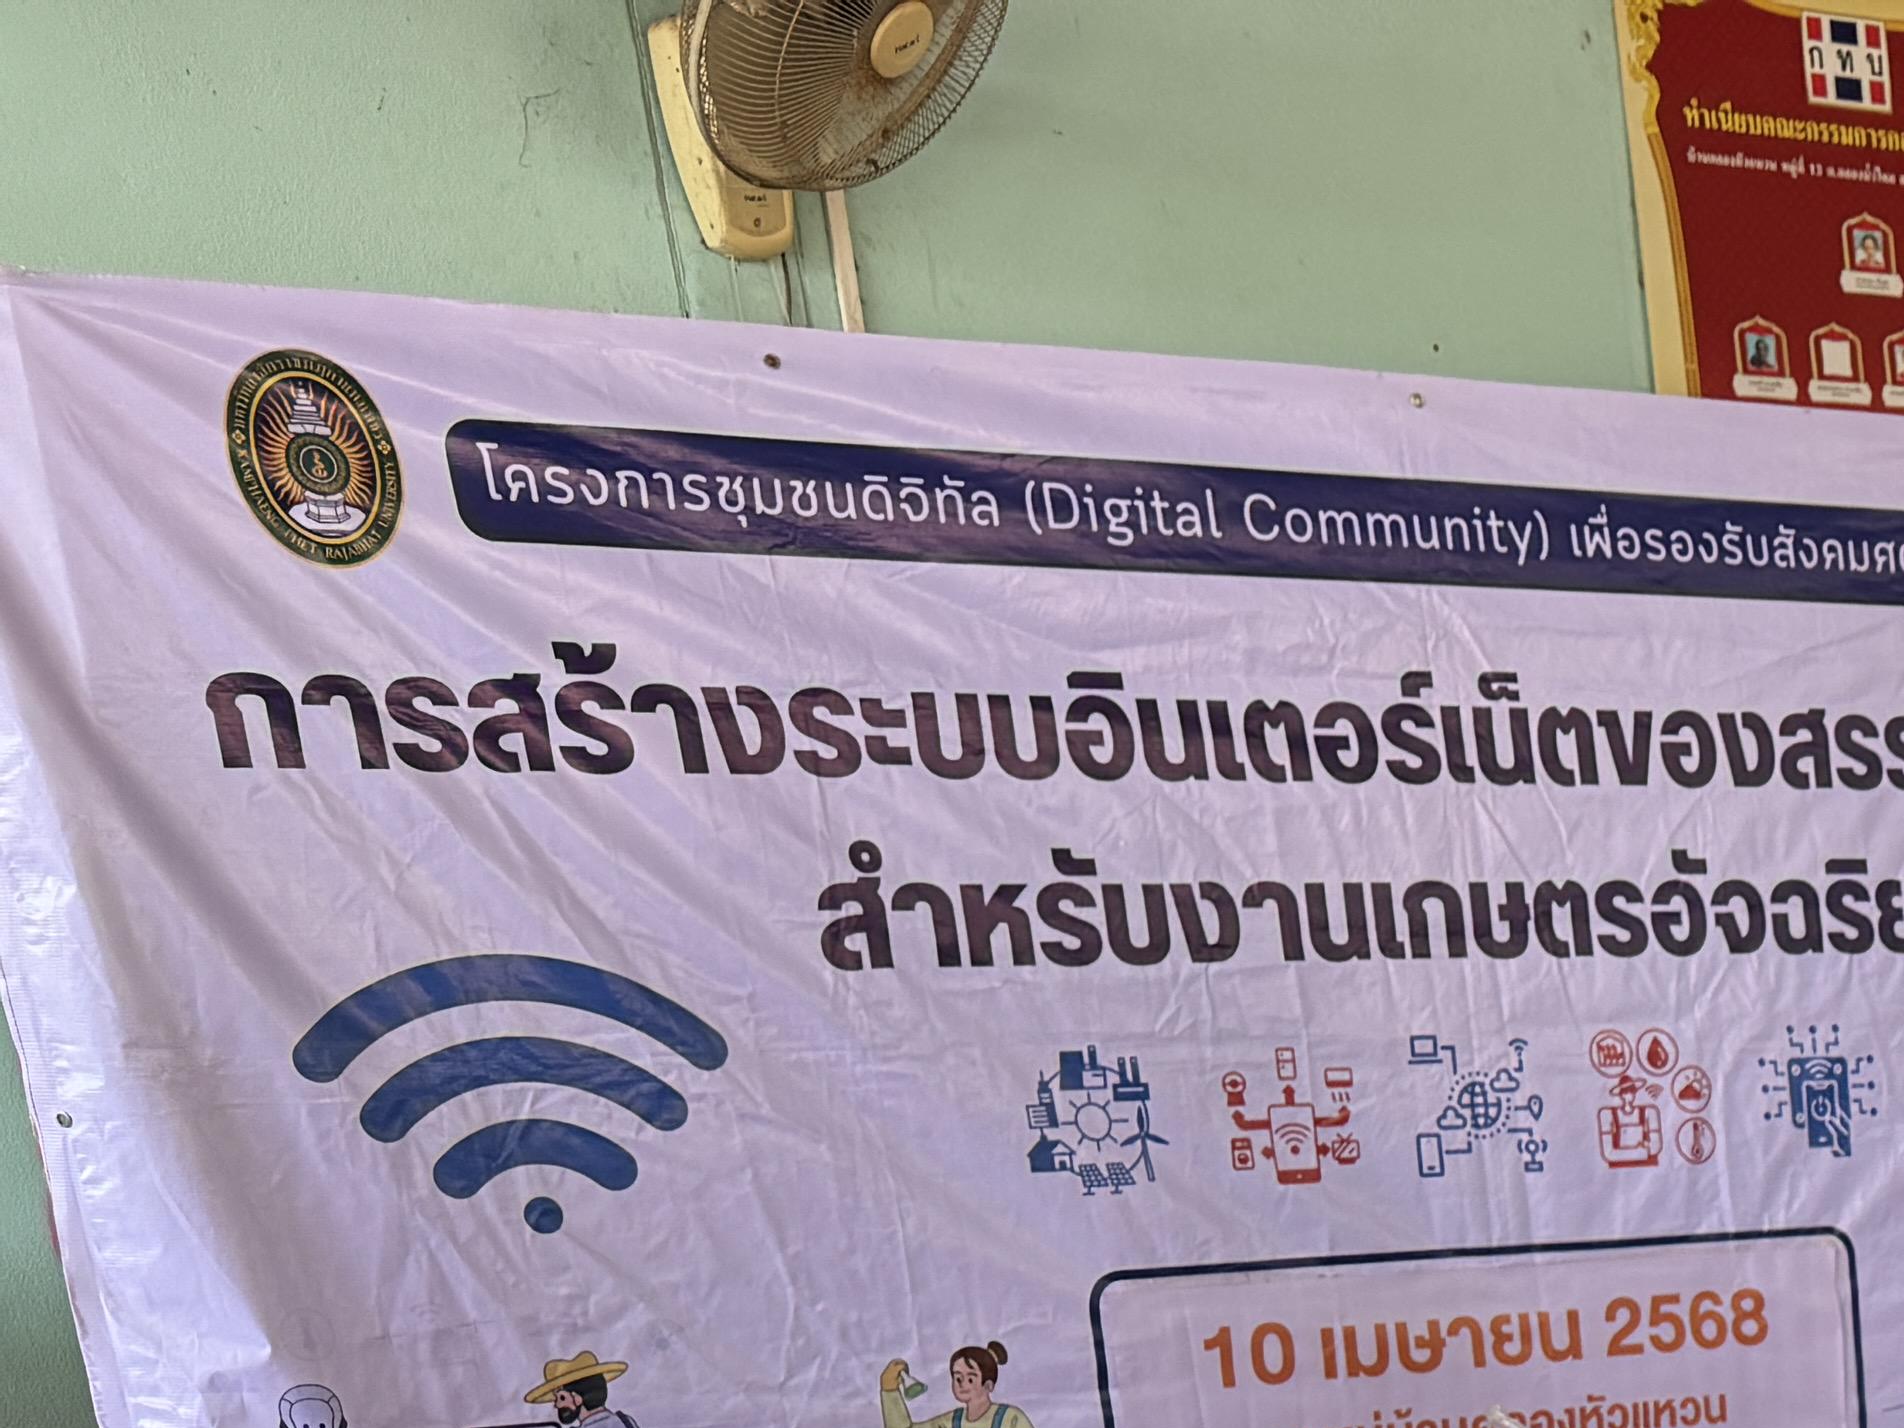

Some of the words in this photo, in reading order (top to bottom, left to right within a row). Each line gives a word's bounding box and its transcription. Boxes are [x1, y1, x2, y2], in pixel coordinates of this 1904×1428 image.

[480, 440, 1003, 531] โครงการชุมชนดิจิทัล
[1023, 481, 1222, 548] (Digital
[1243, 487, 1552, 563] Community)
[1202, 1322, 1297, 1390] 10
[1321, 1307, 1584, 1381] เมษายน
[1603, 1286, 1770, 1359] 2568
